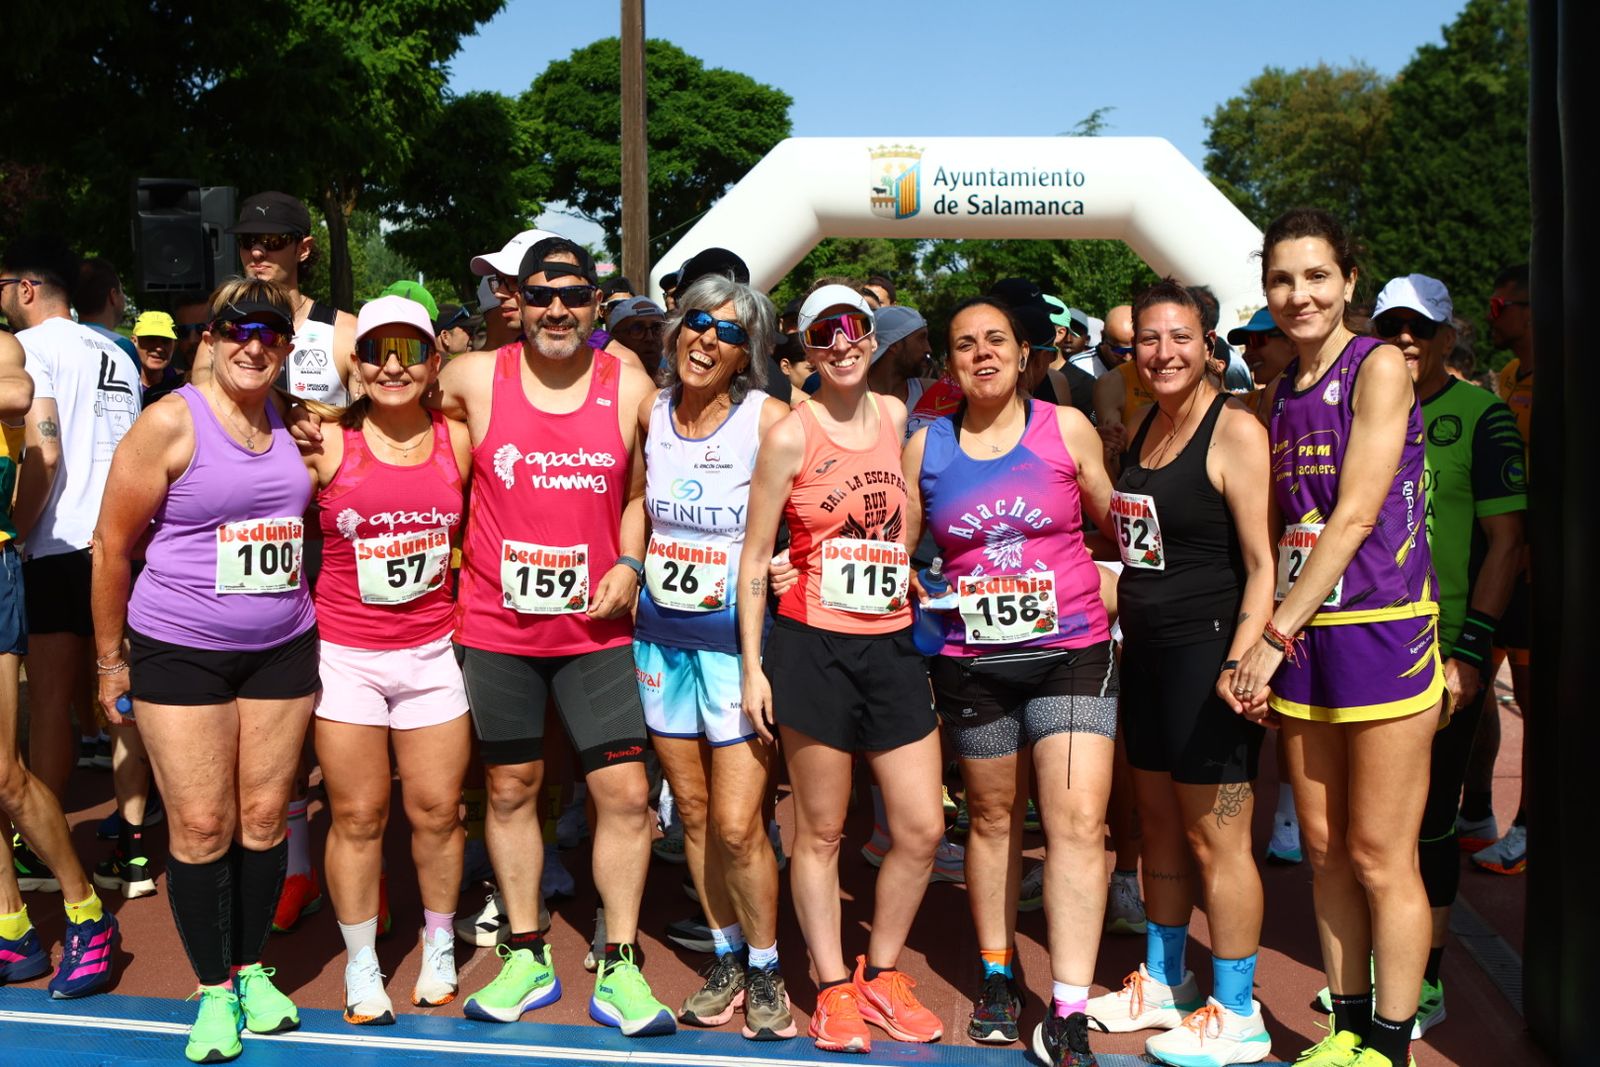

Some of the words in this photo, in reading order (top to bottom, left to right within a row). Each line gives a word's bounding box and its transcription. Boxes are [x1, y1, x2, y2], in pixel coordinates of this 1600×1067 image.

[933, 165, 1085, 191] Ayuntamiento
[933, 194, 959, 216] de
[967, 193, 1085, 216] Salamanca
[525, 447, 616, 473] apaches
[531, 472, 607, 494] running
[820, 486, 847, 513] BAR
[845, 475, 864, 492] LA
[863, 490, 887, 511] RUN
[1110, 496, 1153, 519] edunia
[219, 521, 302, 543] bedunia
[864, 509, 888, 529] CLUB
[948, 496, 1053, 540] Apaches
[237, 542, 293, 577] 100
[358, 532, 447, 560] bedunia
[649, 537, 728, 566] bedunia
[824, 541, 909, 566] bedunia
[386, 552, 427, 588] 57
[516, 566, 577, 599] 159
[662, 561, 699, 595] 26
[841, 563, 897, 598] 115
[976, 594, 1041, 626] 158
